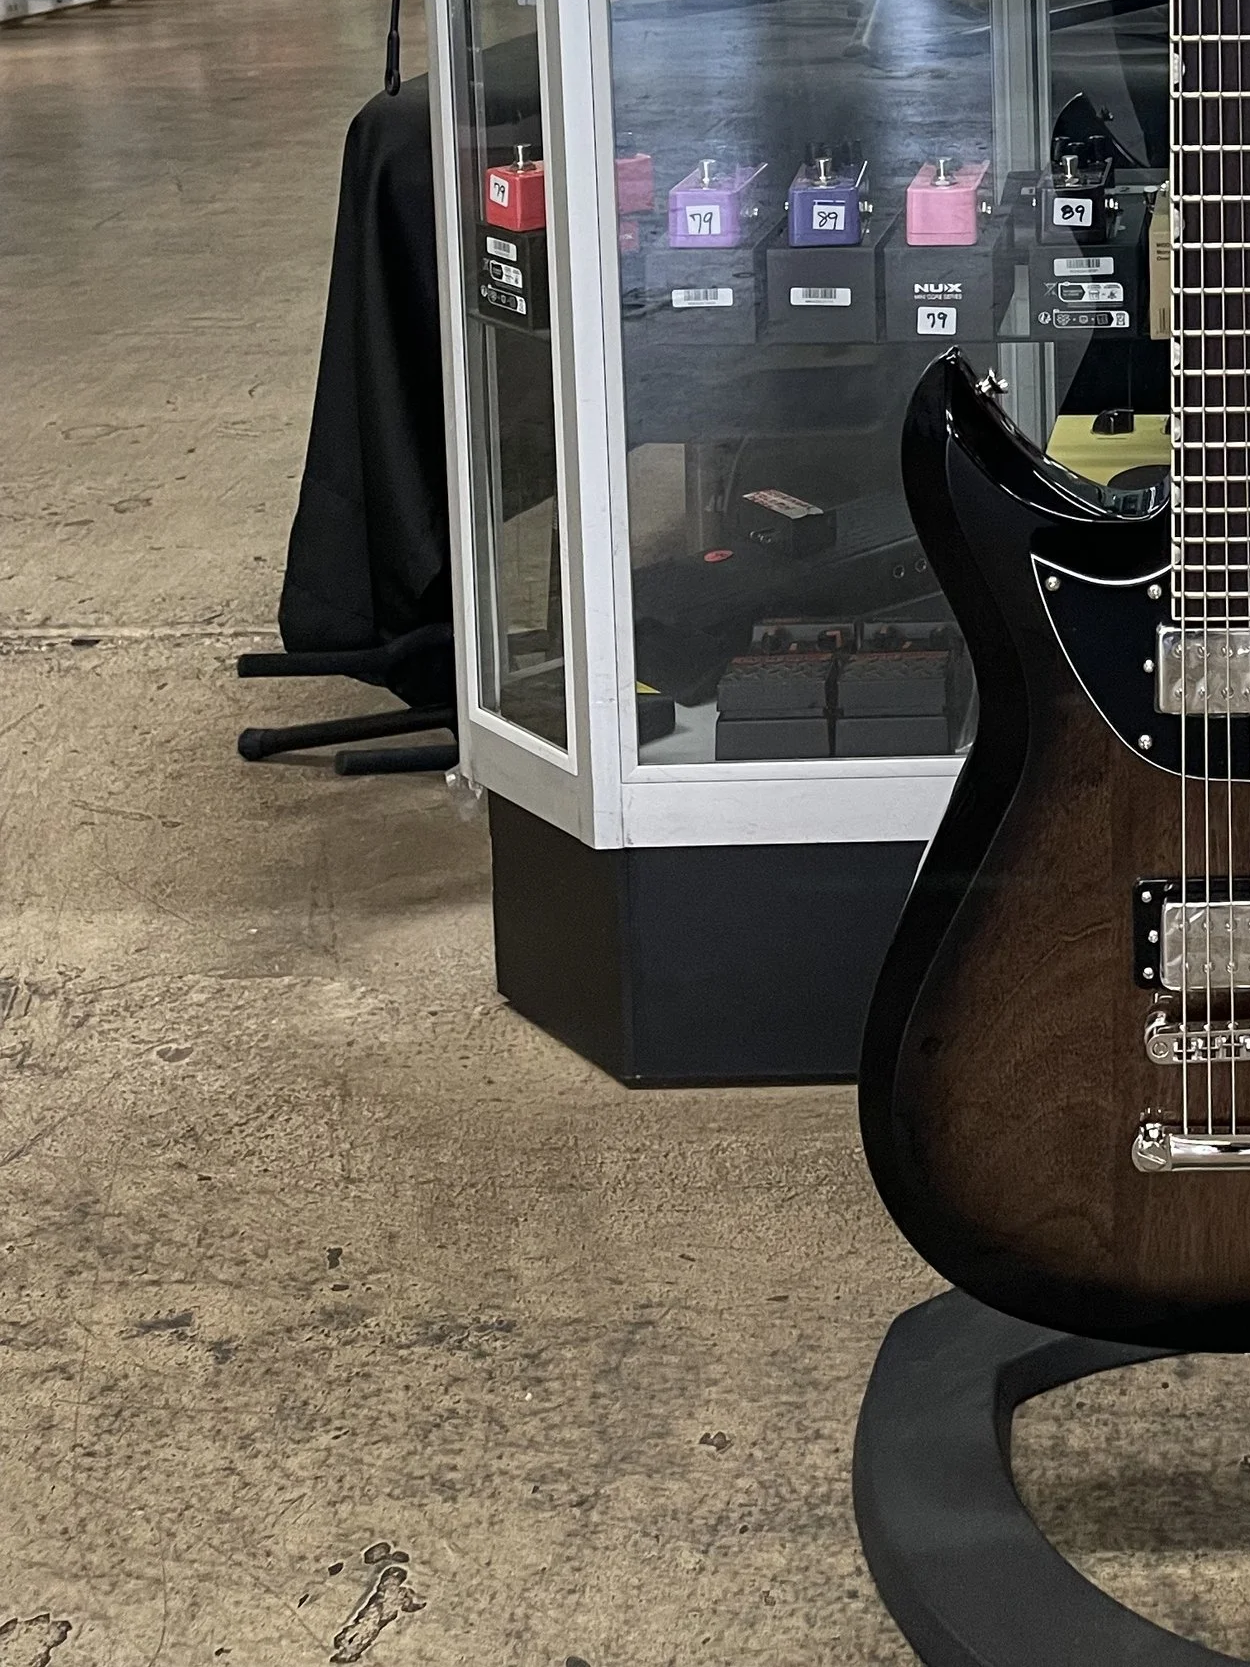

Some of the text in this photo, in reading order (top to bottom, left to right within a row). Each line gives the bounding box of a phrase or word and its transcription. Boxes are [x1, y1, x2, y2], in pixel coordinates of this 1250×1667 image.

[493, 182, 506, 203] 79
[689, 211, 714, 235] 79
[816, 210, 839, 231] 89
[1060, 204, 1086, 223] 89
[914, 282, 963, 294] NUX
[926, 311, 948, 329] 79
